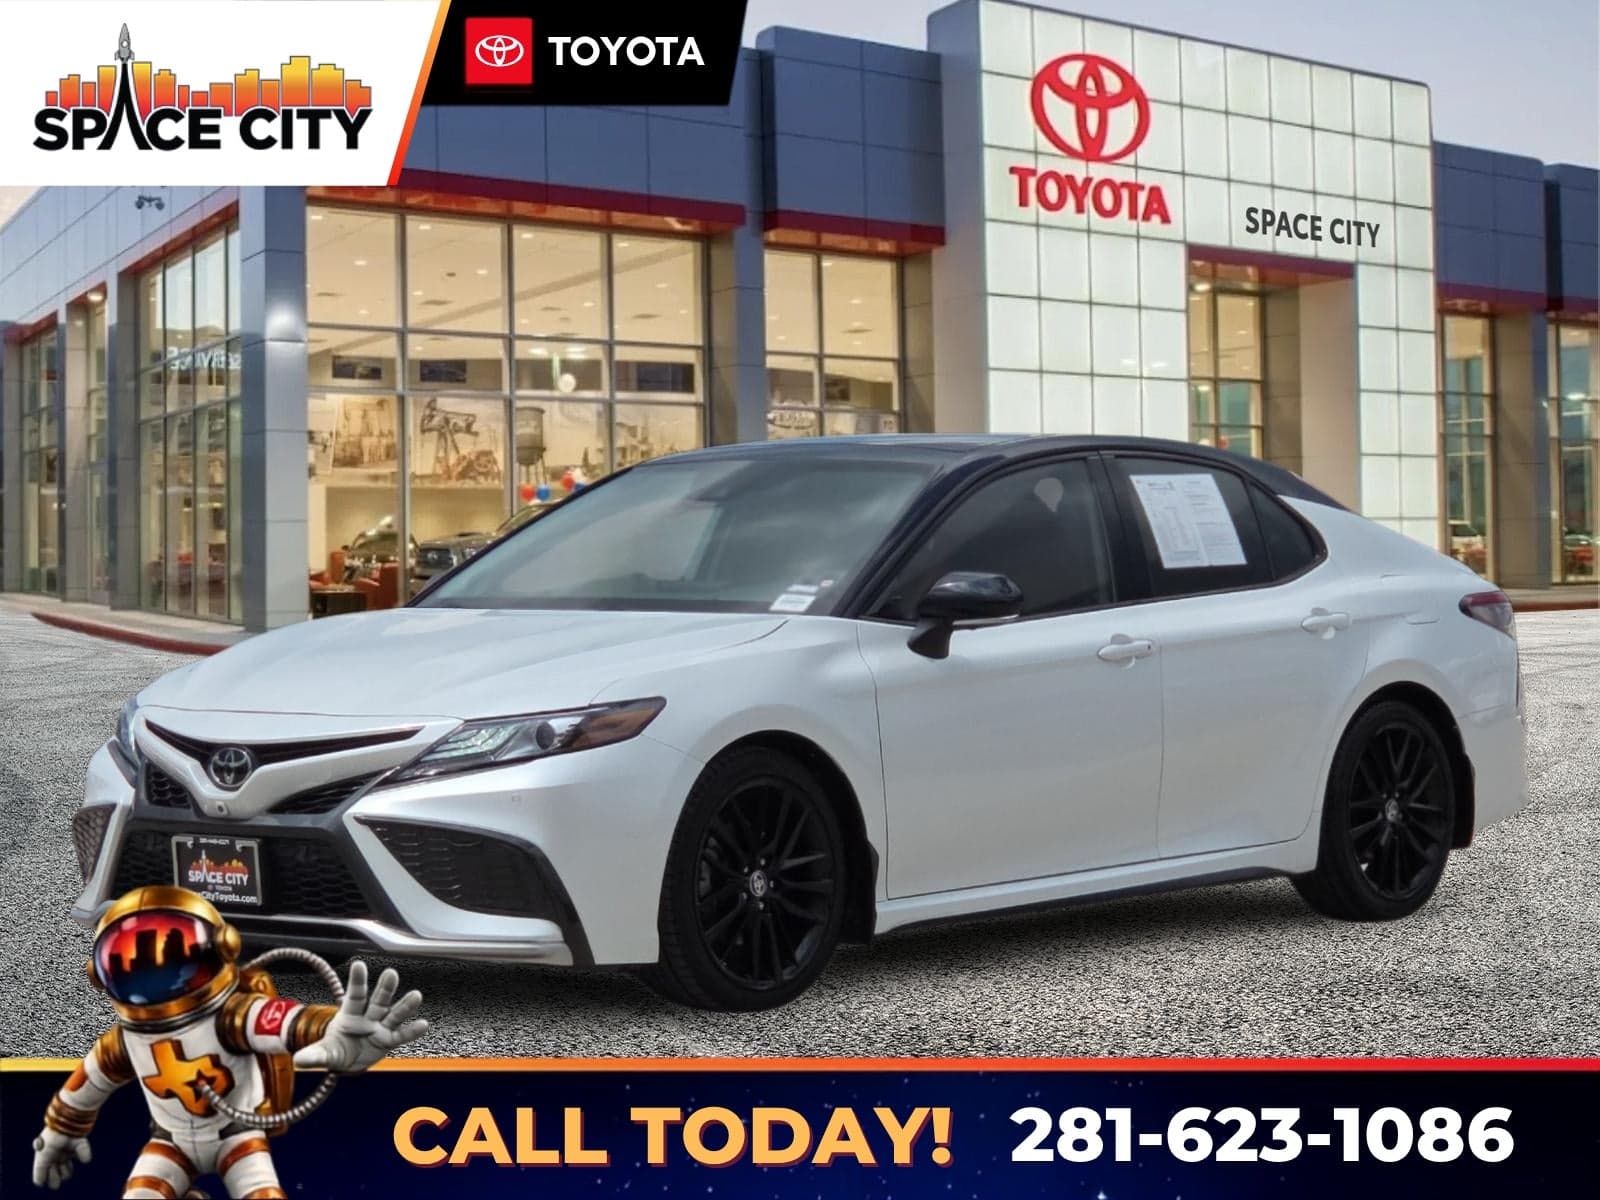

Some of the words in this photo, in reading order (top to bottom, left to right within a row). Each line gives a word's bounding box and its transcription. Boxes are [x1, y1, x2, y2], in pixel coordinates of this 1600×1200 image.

[1009, 166, 1171, 224] TOYOTA
[1245, 206, 1323, 242] SPACE
[1329, 218, 1381, 248] CITY
[188, 870, 223, 883] SPACE
[225, 872, 248, 886] CITY
